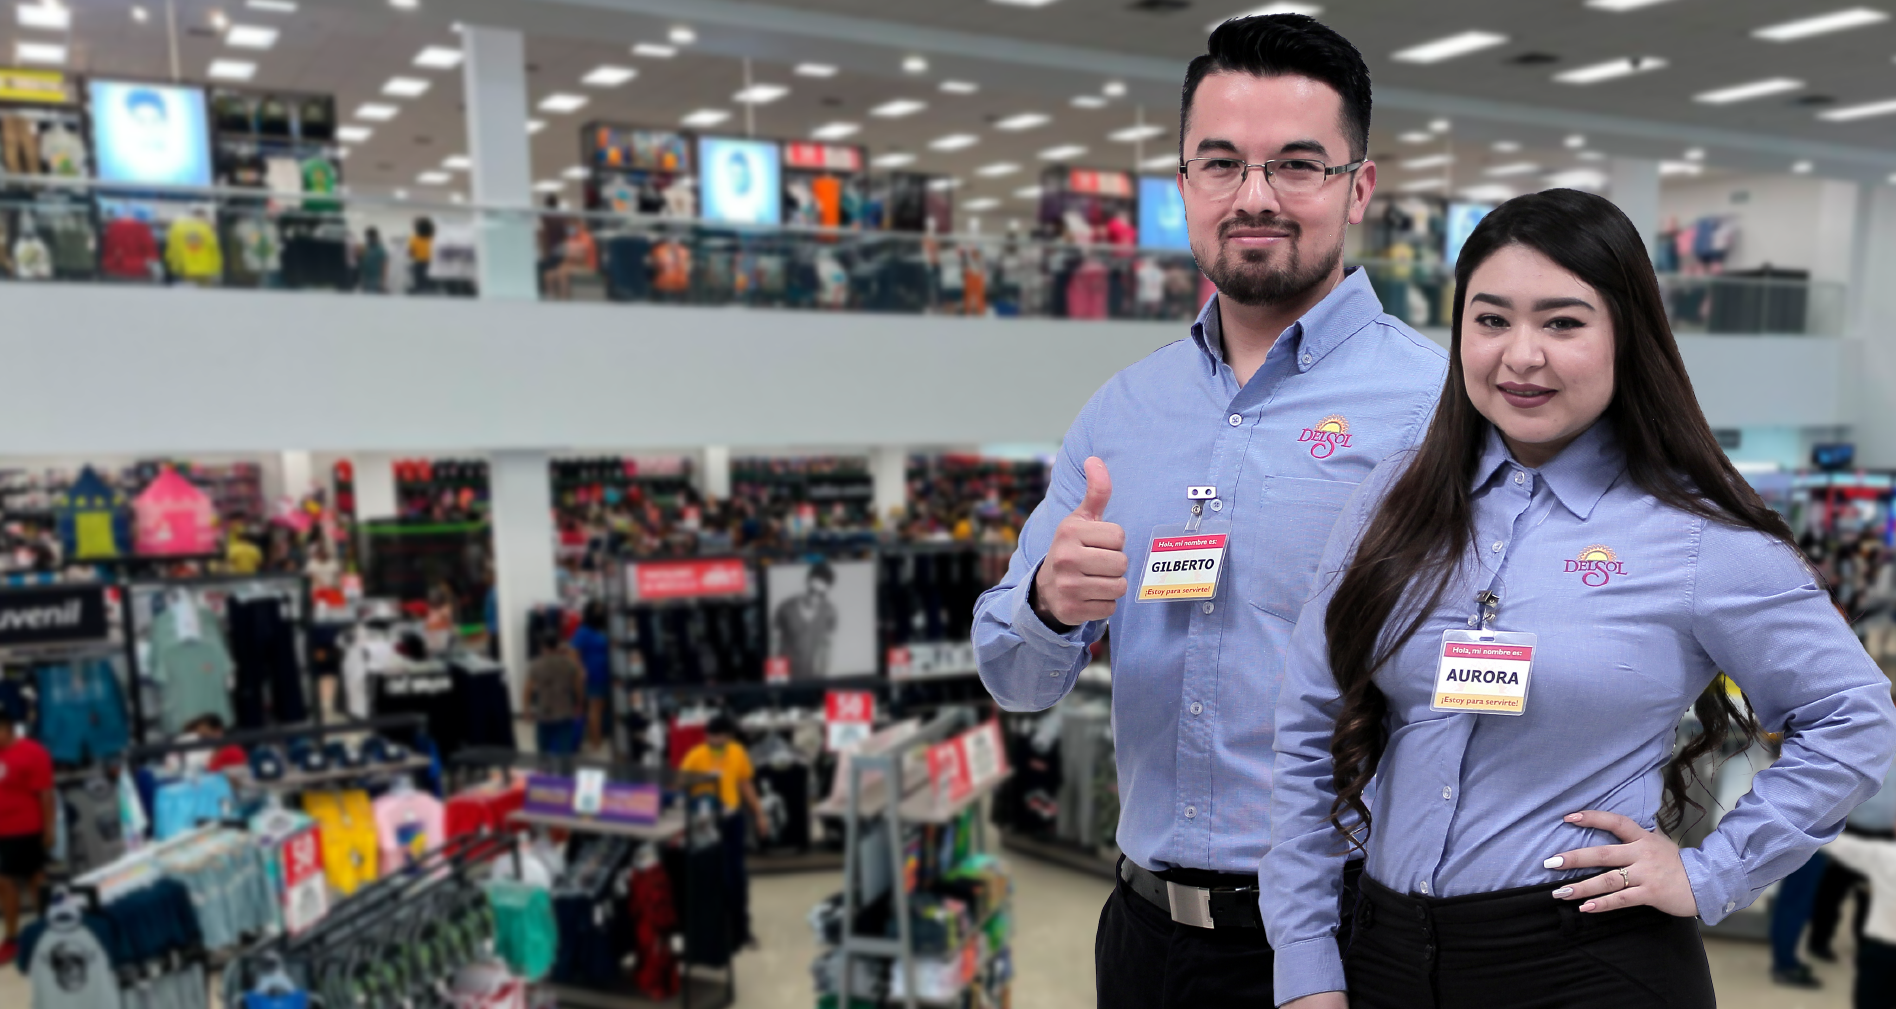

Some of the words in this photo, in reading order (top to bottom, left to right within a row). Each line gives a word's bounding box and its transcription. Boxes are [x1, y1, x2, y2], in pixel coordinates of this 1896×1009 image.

[1151, 558, 1215, 573] GILBERTO
[1144, 588, 1165, 597] ¡Estoy
[1165, 588, 1181, 596] para
[1452, 646, 1471, 655] Hola,
[1482, 648, 1511, 656] nombre
[1446, 668, 1519, 685] AURORA
[1441, 696, 1465, 705] ¡Estoy
[1466, 698, 1484, 706] para
[1485, 698, 1519, 707] servirte!
